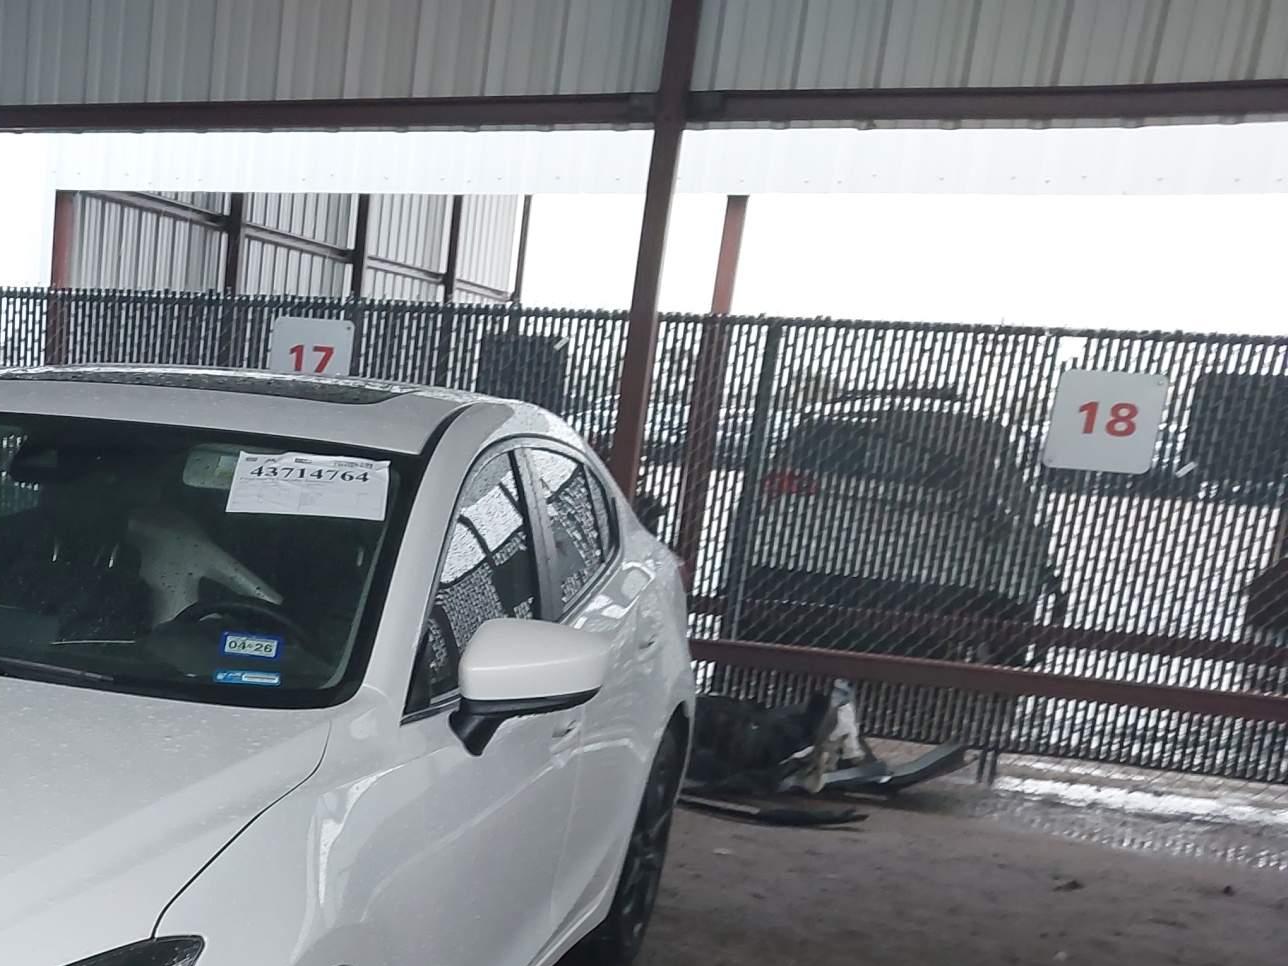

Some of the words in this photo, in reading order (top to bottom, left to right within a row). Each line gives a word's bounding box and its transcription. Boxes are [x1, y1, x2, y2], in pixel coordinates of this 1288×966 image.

[289, 345, 335, 373] 17
[1079, 401, 1139, 437] 18
[250, 466, 369, 482] 43714764
